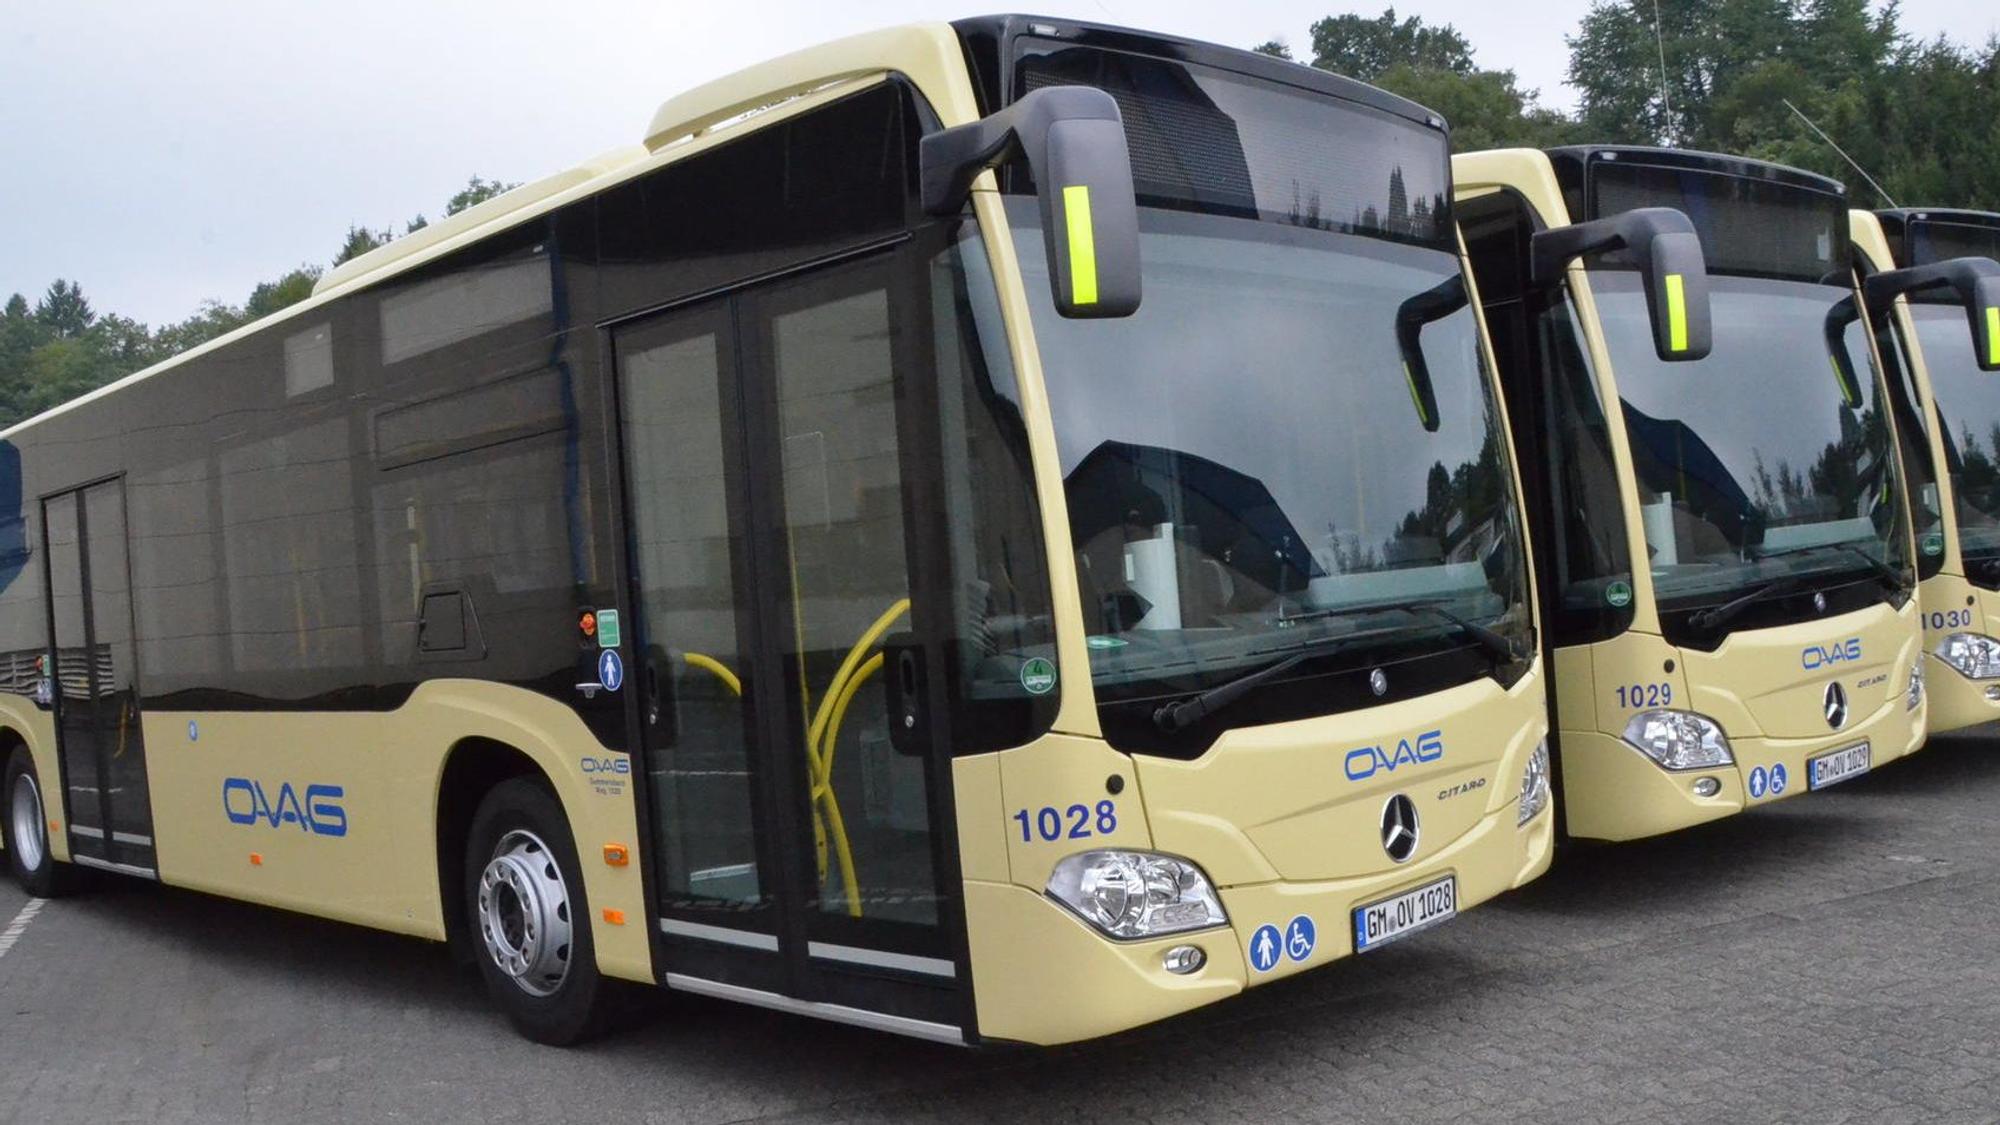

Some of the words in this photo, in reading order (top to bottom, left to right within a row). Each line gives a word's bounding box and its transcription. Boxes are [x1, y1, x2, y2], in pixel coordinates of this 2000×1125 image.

[1921, 609, 1971, 631] 1030
[1802, 638, 1862, 671] OVAG
[1616, 682, 1672, 709] 1029
[580, 757, 629, 774] OVAG
[1344, 729, 1443, 782] OVAG
[1436, 778, 1487, 801] CITARO
[222, 777, 348, 837] OVAG
[1013, 799, 1117, 842] 1028
[1367, 907, 1388, 939] GM
[1397, 896, 1415, 928] OV
[1418, 882, 1452, 921] 1028
